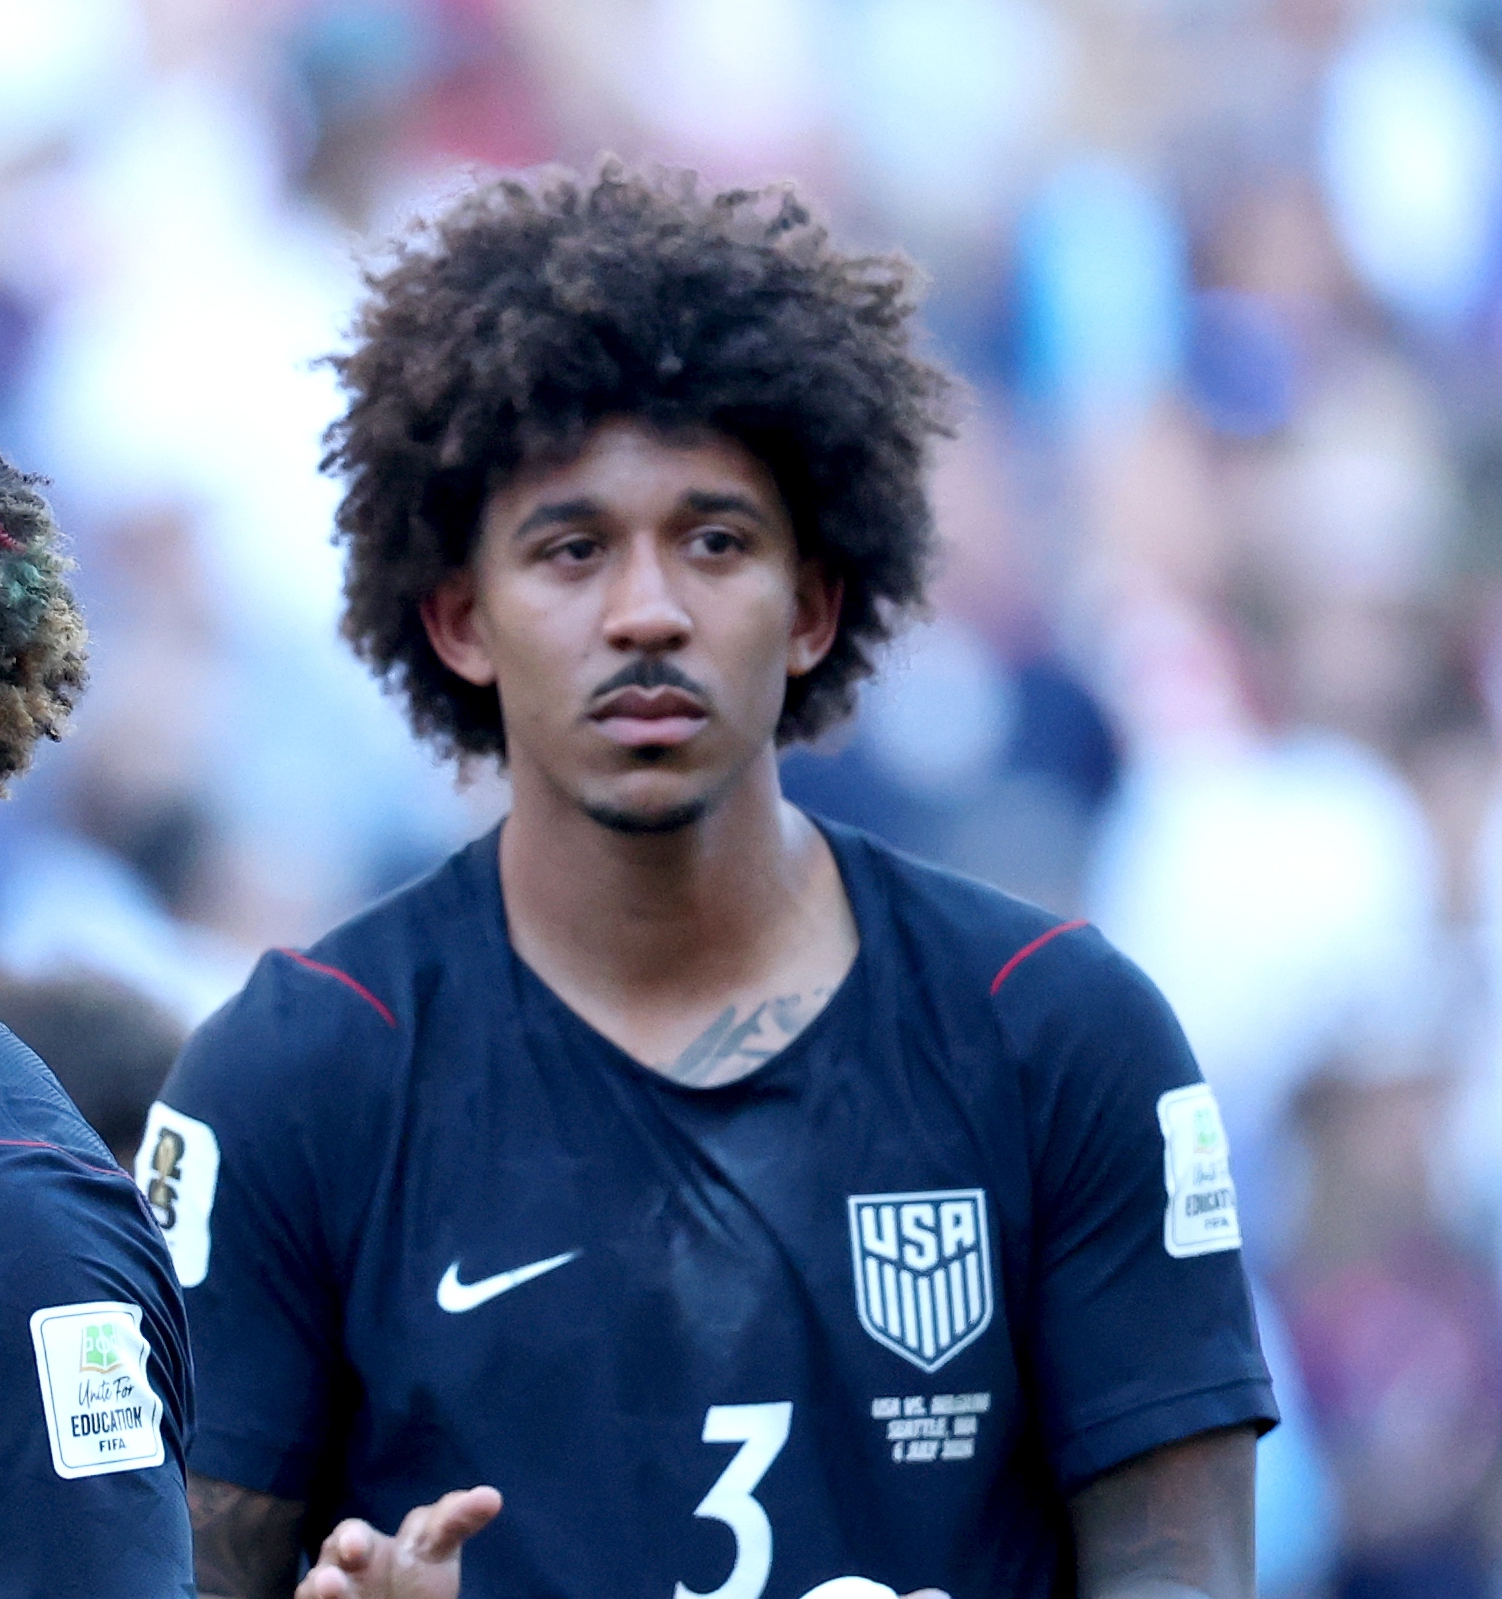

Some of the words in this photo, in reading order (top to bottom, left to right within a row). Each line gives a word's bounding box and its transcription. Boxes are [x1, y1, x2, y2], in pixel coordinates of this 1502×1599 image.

[860, 1200, 976, 1271] USA
[113, 1375, 135, 1403] For
[70, 1405, 143, 1438] EDUCATION
[99, 1437, 126, 1453] FIFA
